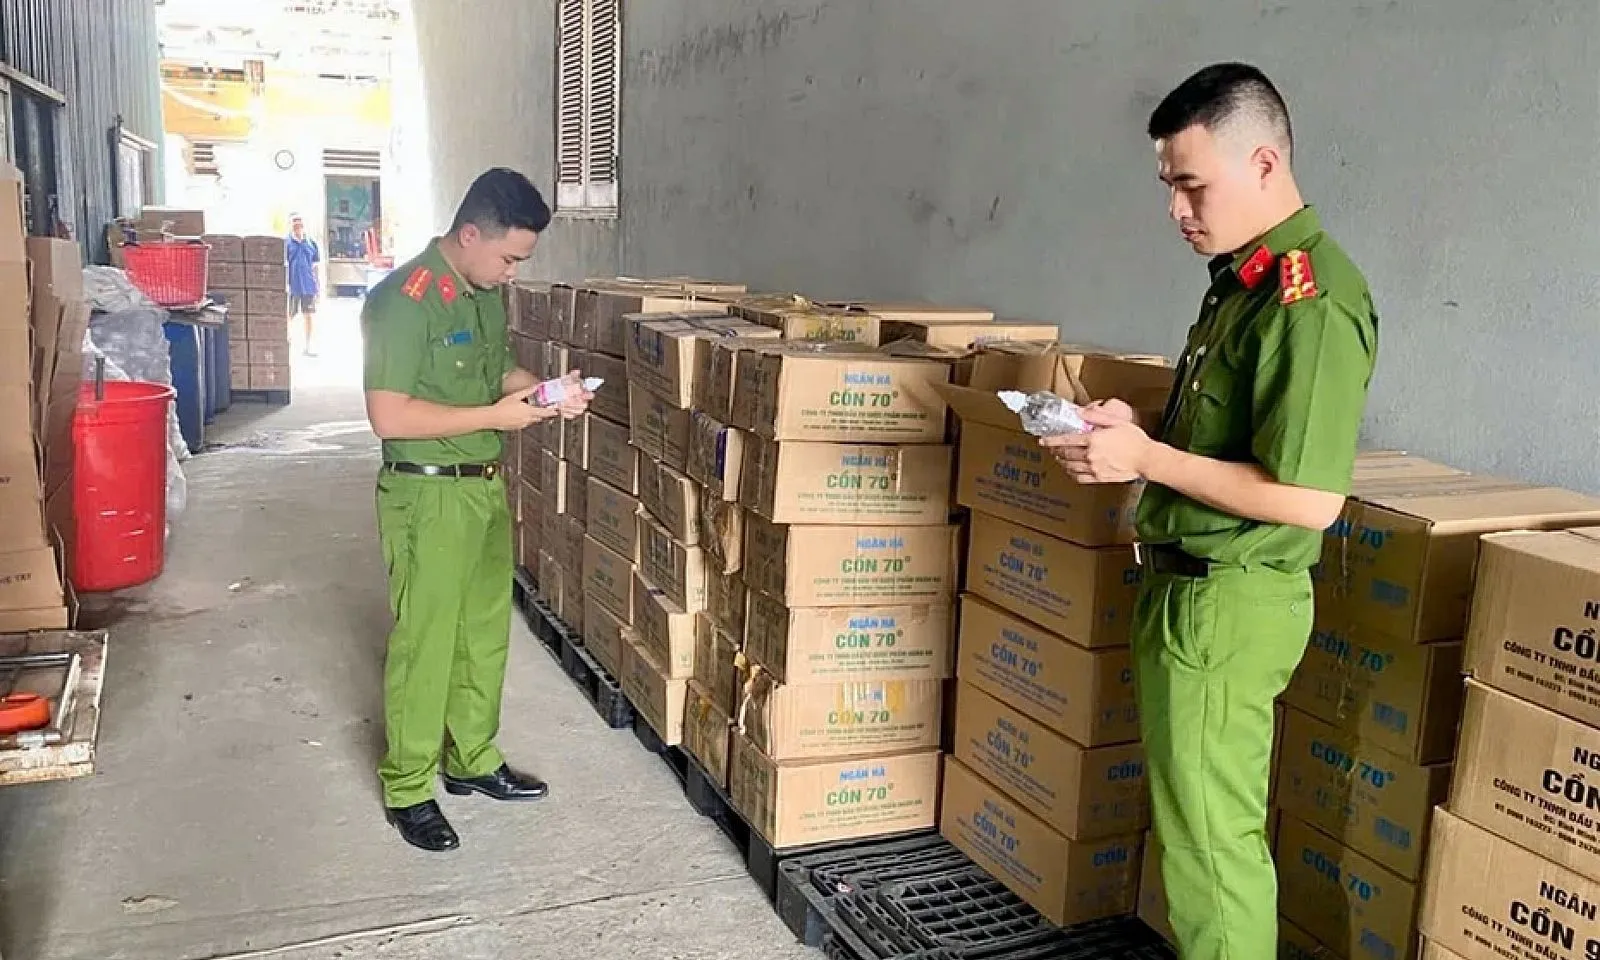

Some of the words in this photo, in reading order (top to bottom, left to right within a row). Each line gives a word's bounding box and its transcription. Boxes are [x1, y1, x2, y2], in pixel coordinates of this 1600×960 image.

[1504, 640, 1531, 658] CÔNG
[1554, 627, 1600, 663] CỒ
[1493, 777, 1521, 797] CÔNG
[1462, 904, 1489, 925] CÔNG
[1540, 880, 1596, 921] NGÂN
[1510, 900, 1575, 950] CỒN
